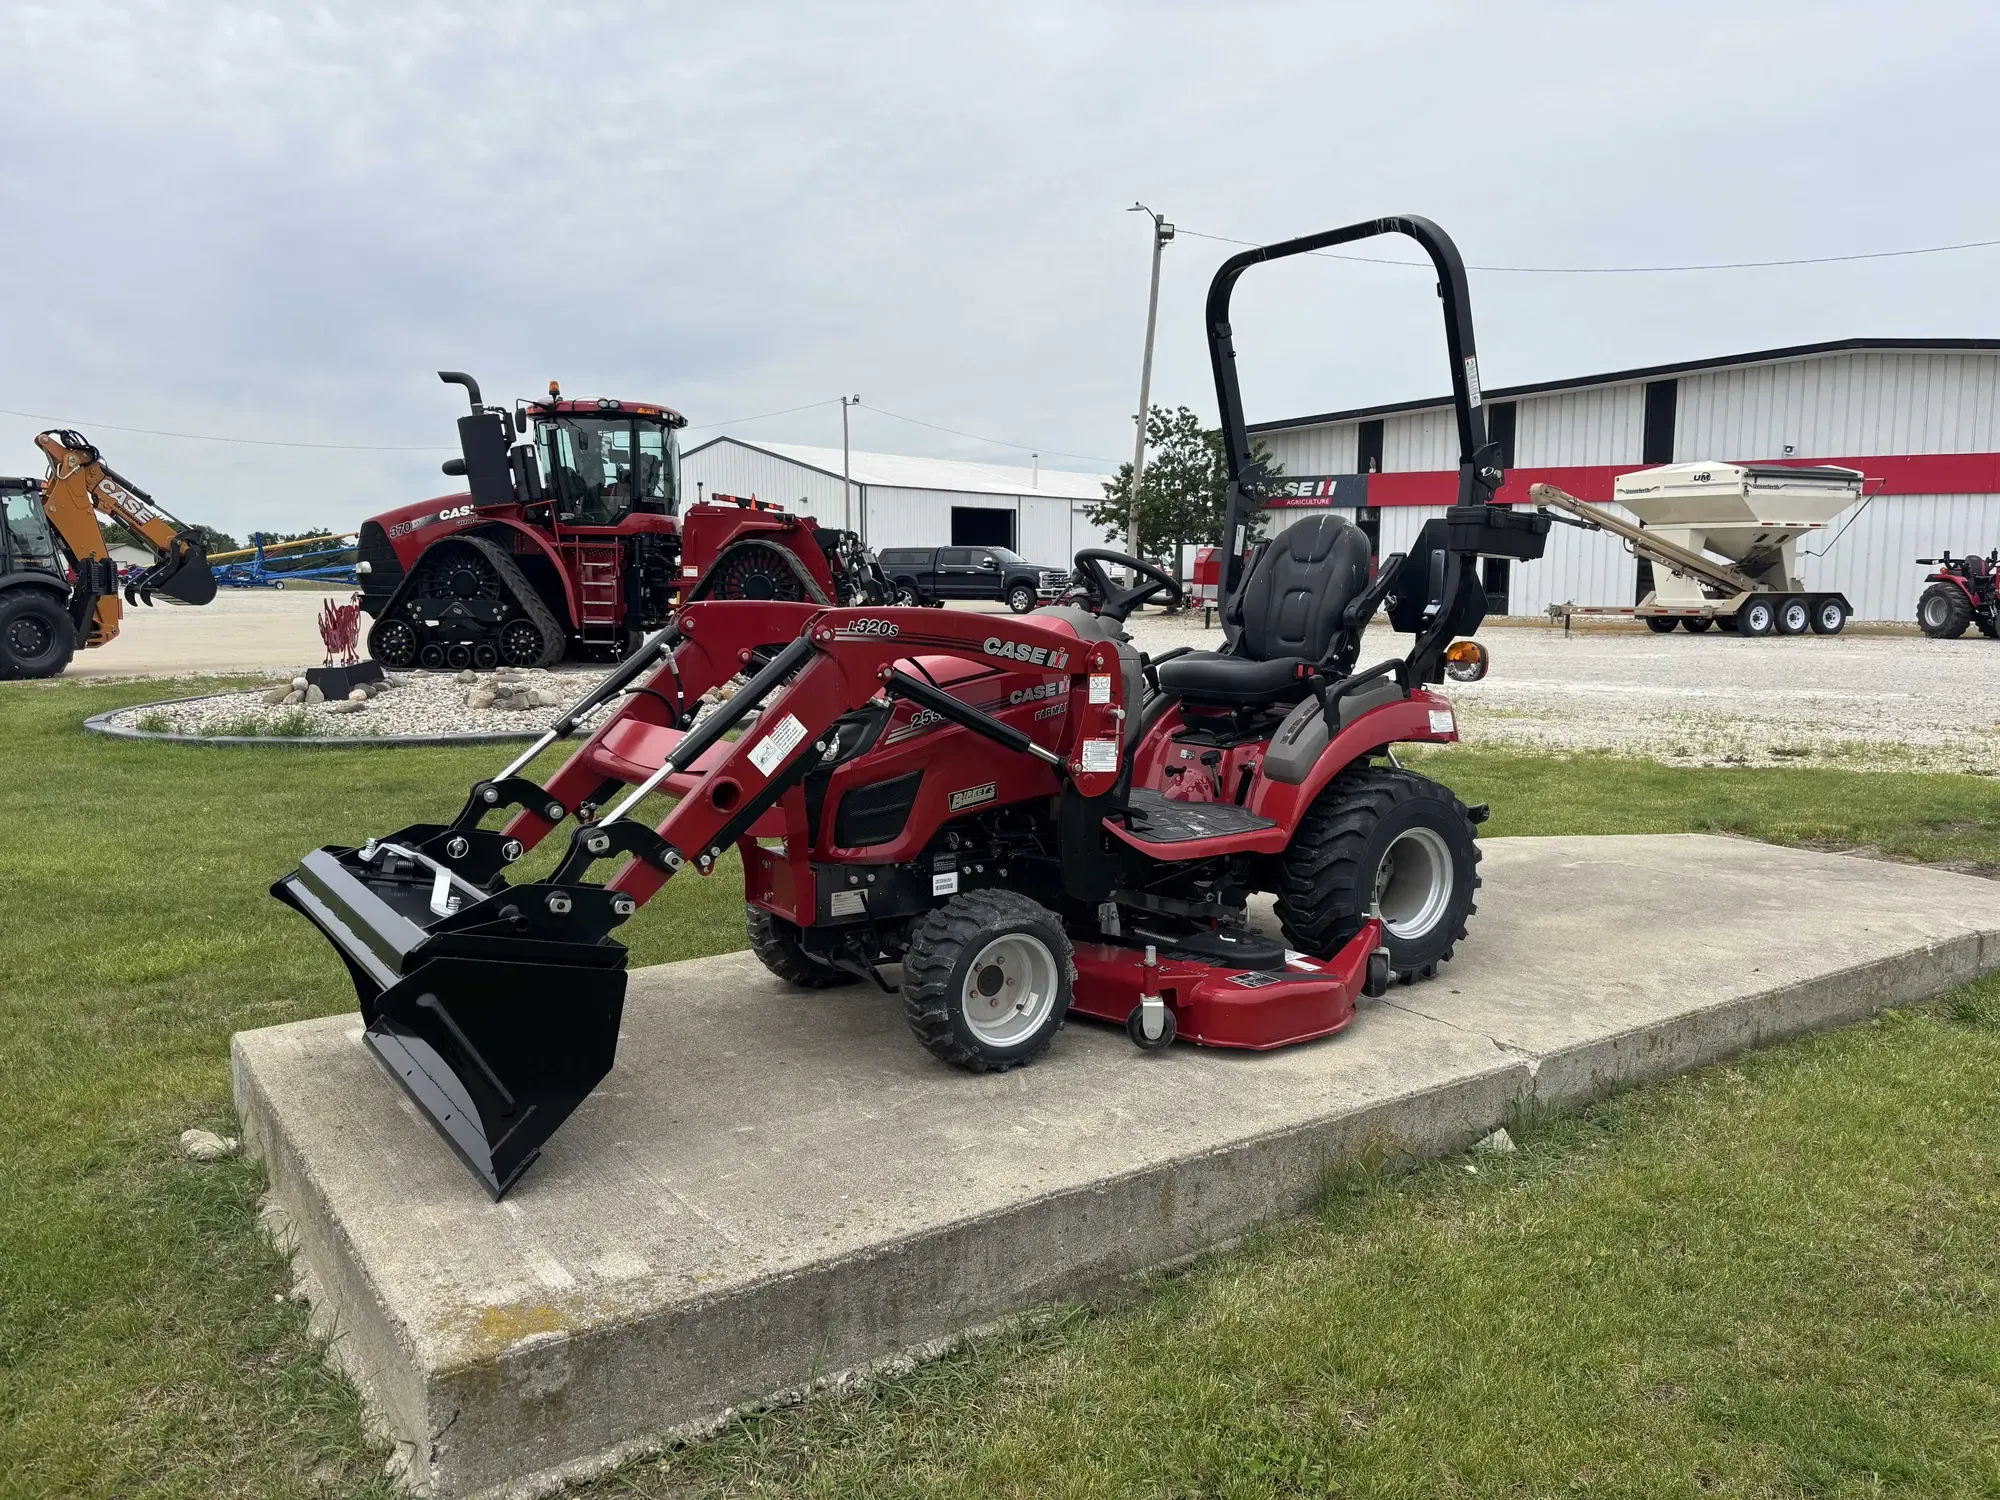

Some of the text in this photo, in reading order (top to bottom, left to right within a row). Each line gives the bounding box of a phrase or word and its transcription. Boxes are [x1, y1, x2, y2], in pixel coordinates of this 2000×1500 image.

[98, 479, 154, 524] CASE
[389, 521, 412, 539] 370
[983, 637, 1047, 665] CASE
[1010, 682, 1056, 704] CASE
